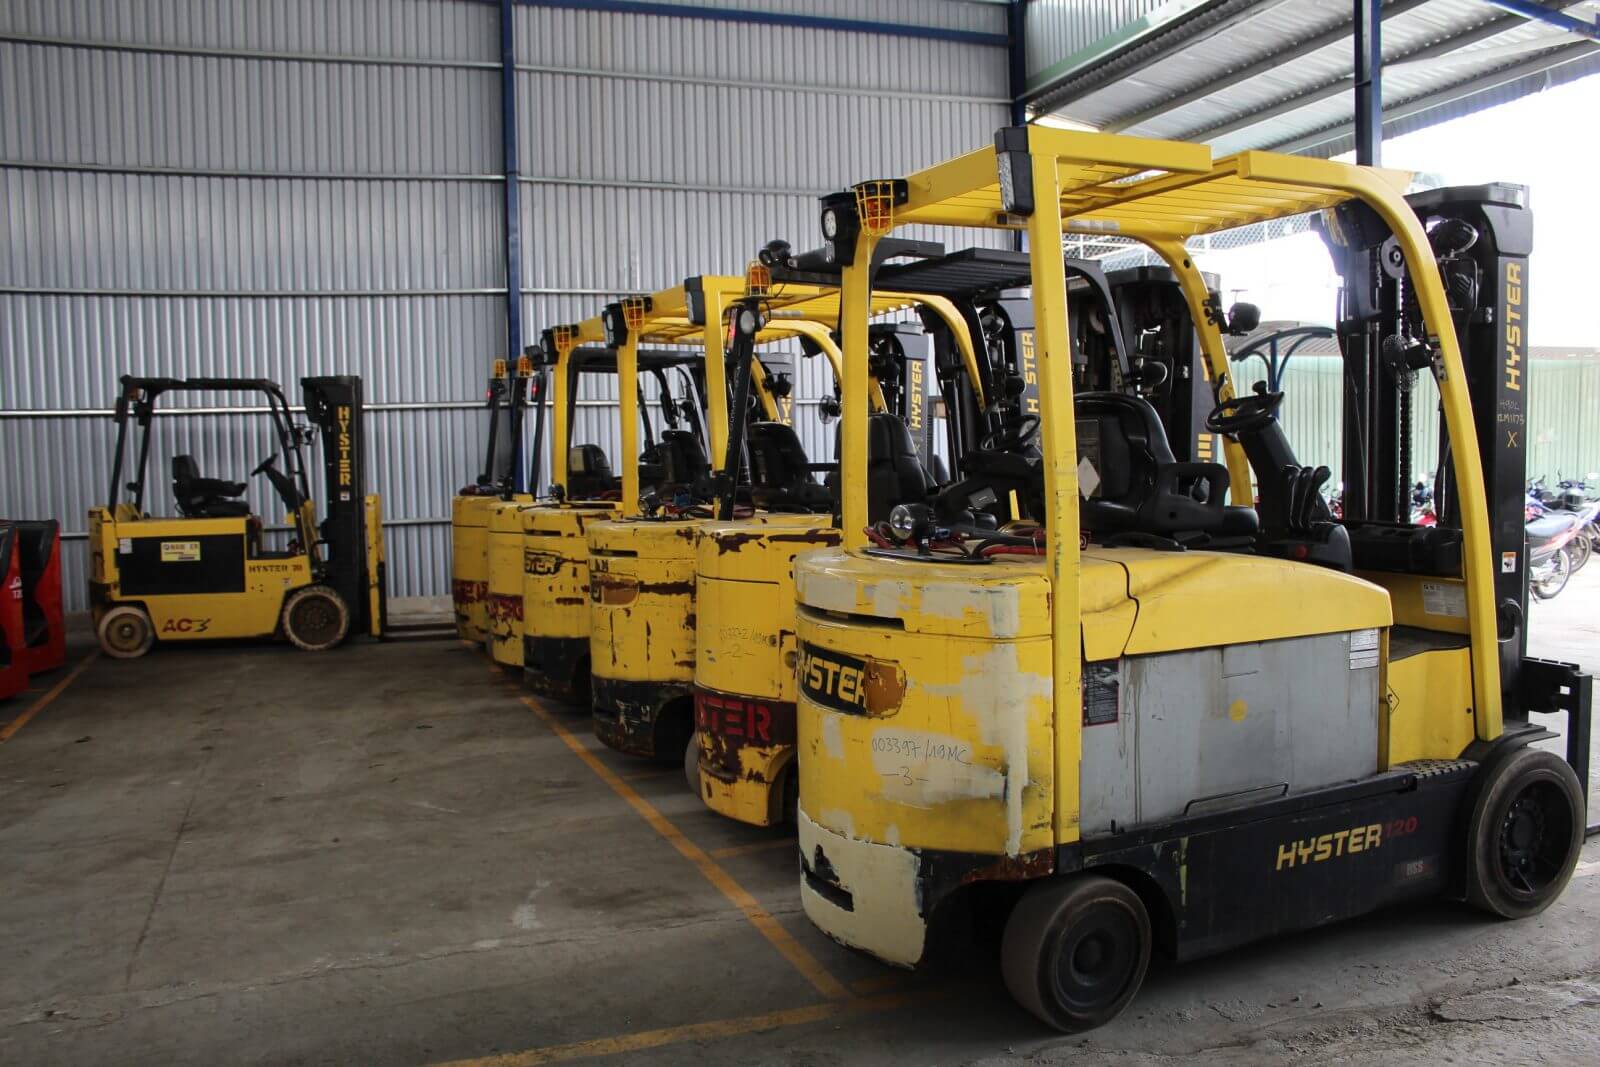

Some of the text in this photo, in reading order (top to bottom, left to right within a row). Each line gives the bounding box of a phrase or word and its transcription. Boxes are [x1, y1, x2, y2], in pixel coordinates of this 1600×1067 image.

[1505, 262, 1522, 391] HYSTER
[911, 360, 923, 430] HYSTER
[338, 406, 352, 486] HYSTER
[1275, 816, 1418, 871] HYSTER 120
